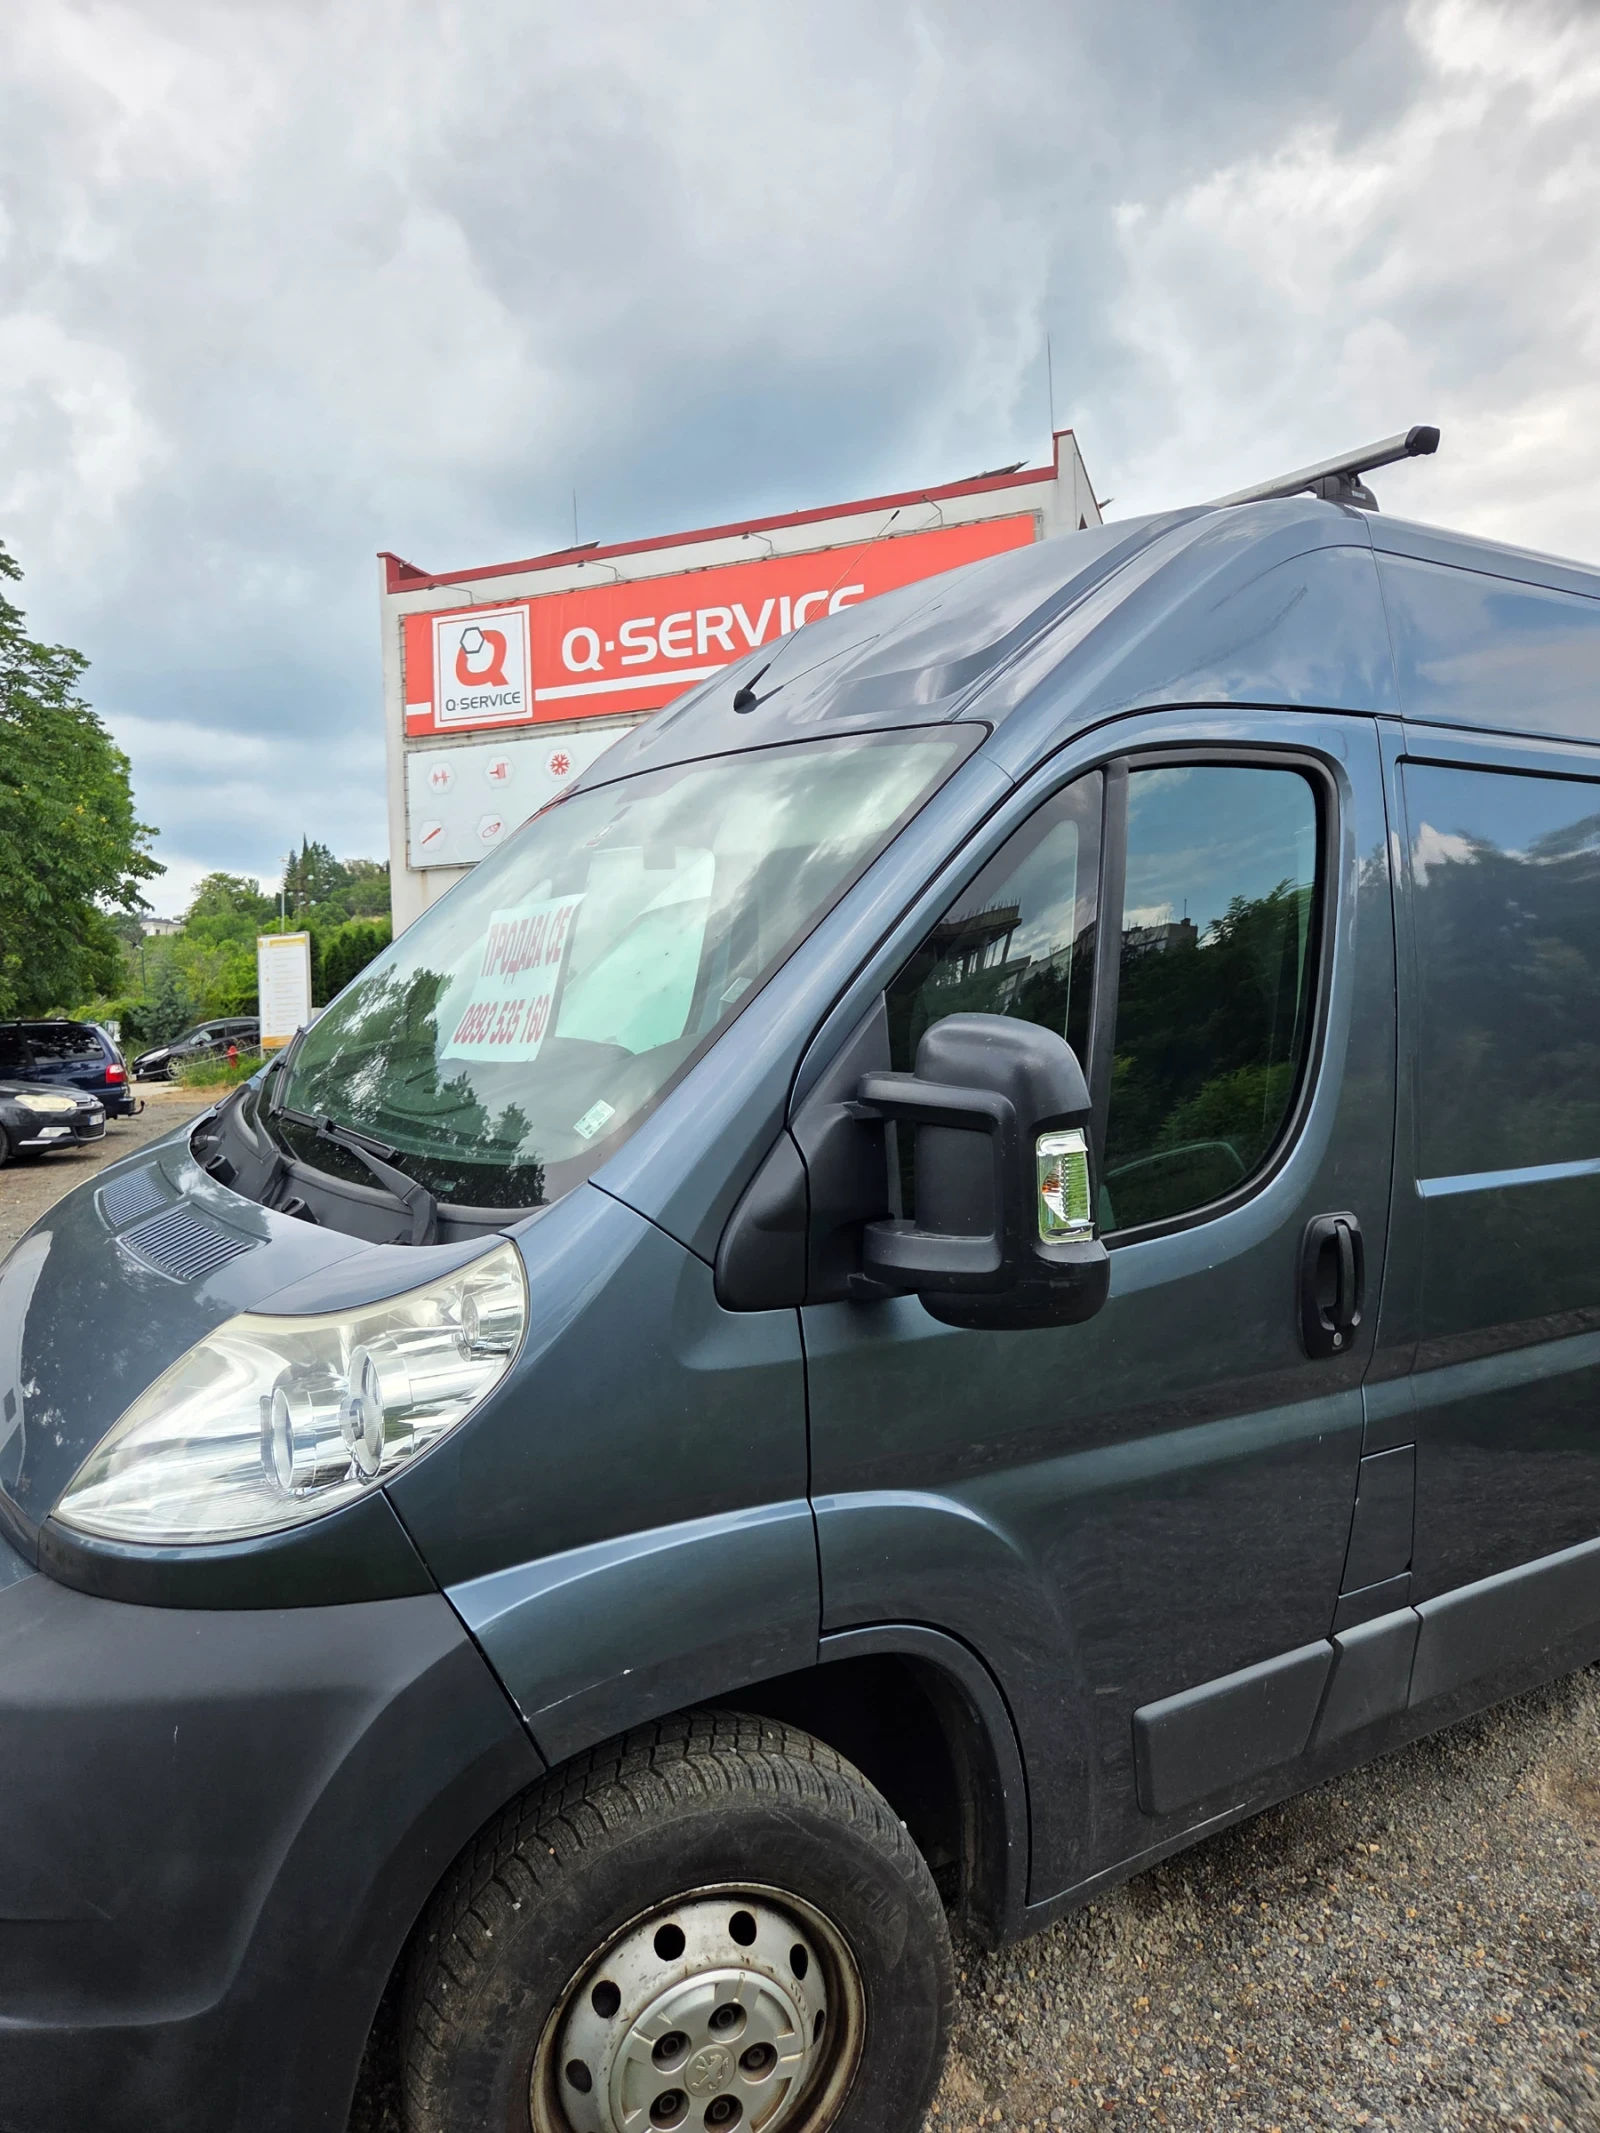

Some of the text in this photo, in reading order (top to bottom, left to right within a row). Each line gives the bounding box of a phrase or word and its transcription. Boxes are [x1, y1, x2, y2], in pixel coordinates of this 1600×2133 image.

[481, 905, 574, 984] ПРОДАВА СЕ
[453, 993, 550, 1044] 0893 535 160
